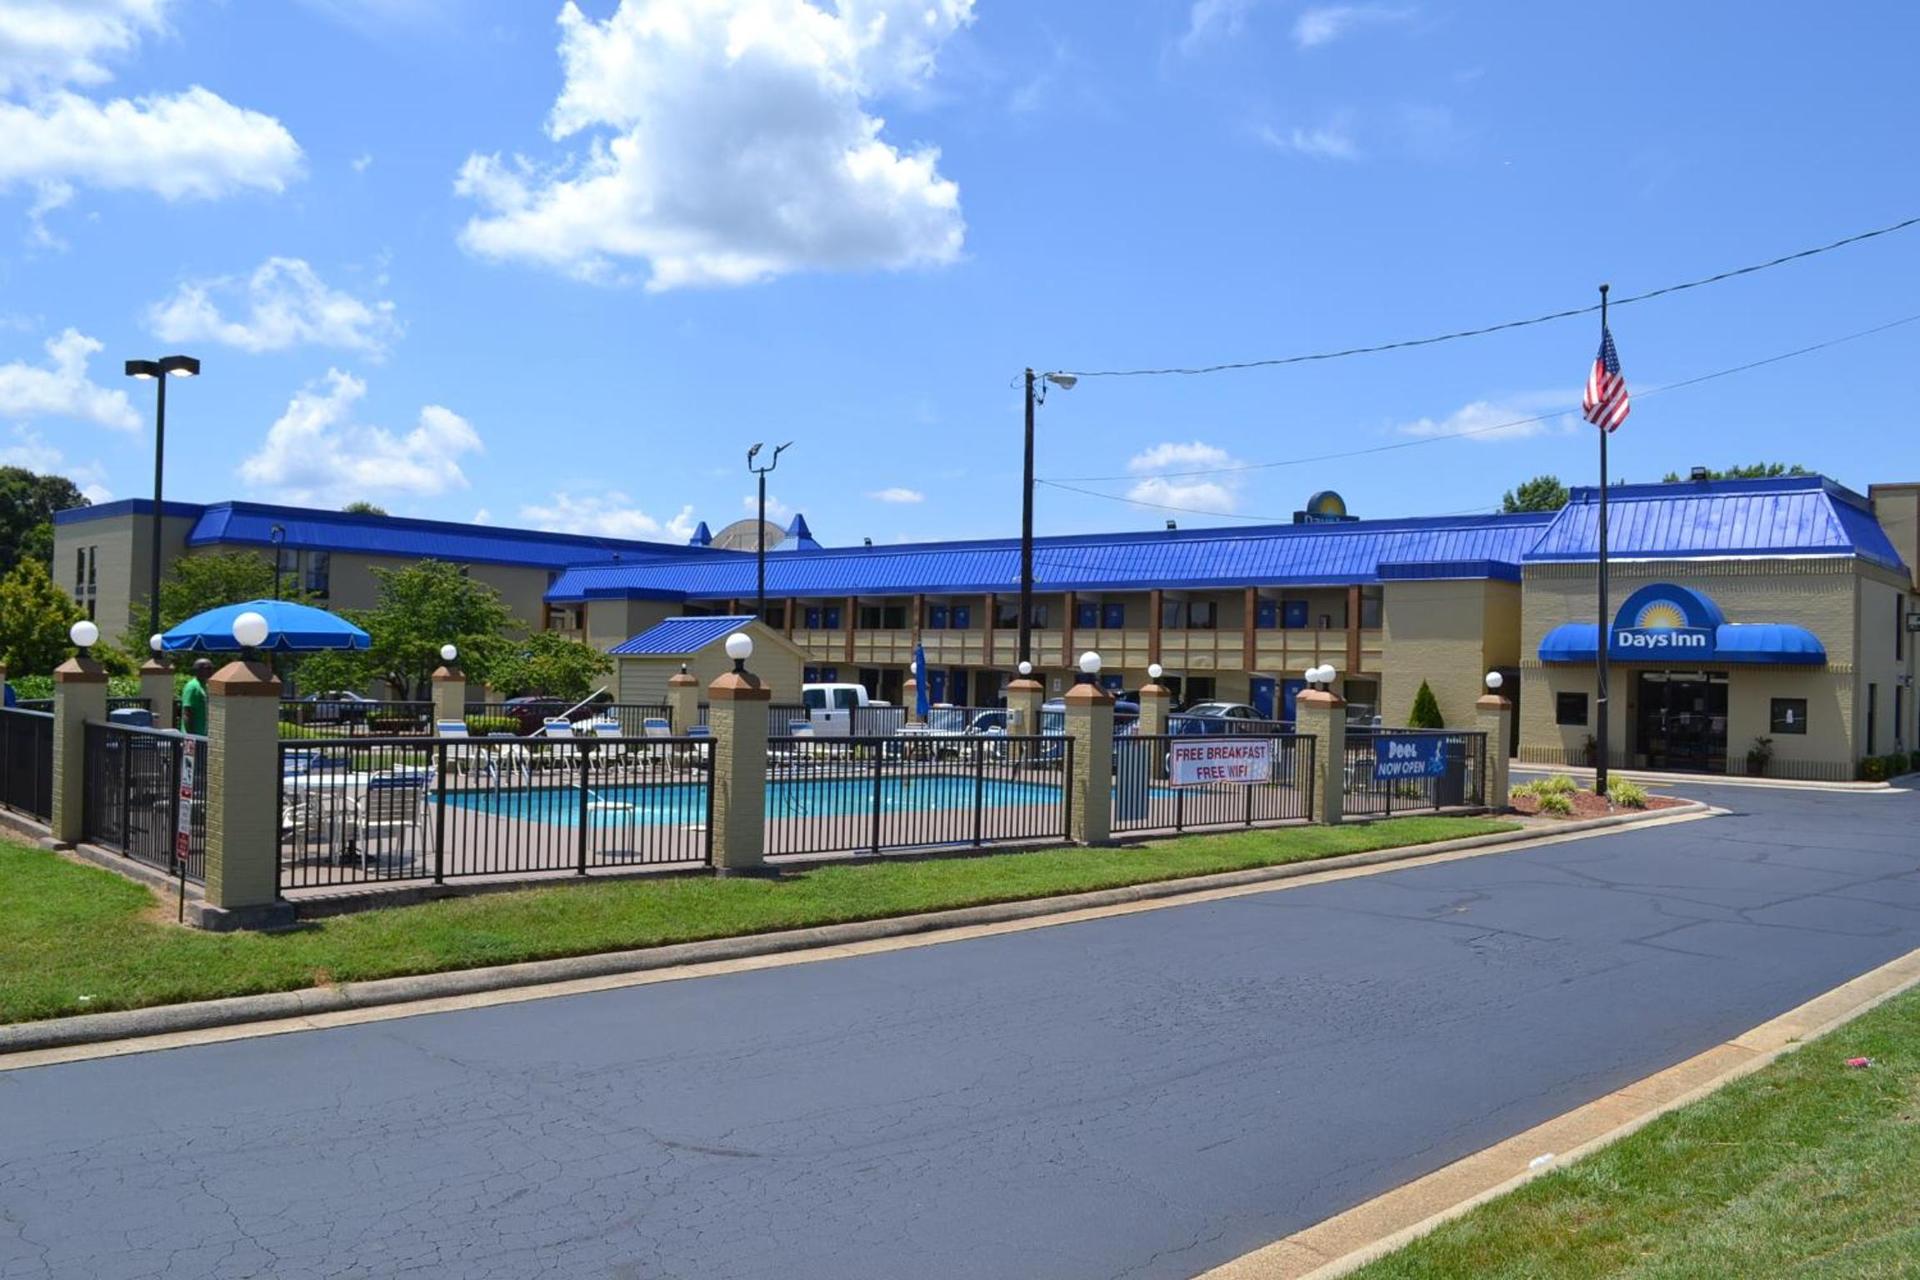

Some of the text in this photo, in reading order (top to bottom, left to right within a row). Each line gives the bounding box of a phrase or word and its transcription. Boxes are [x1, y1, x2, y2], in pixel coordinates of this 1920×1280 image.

[1618, 631, 1706, 649] Days Inn
[1175, 746, 1266, 762] FREE BREAKFAST
[1196, 765, 1226, 780] FREE
[1378, 760, 1426, 776] NOW OPEN
